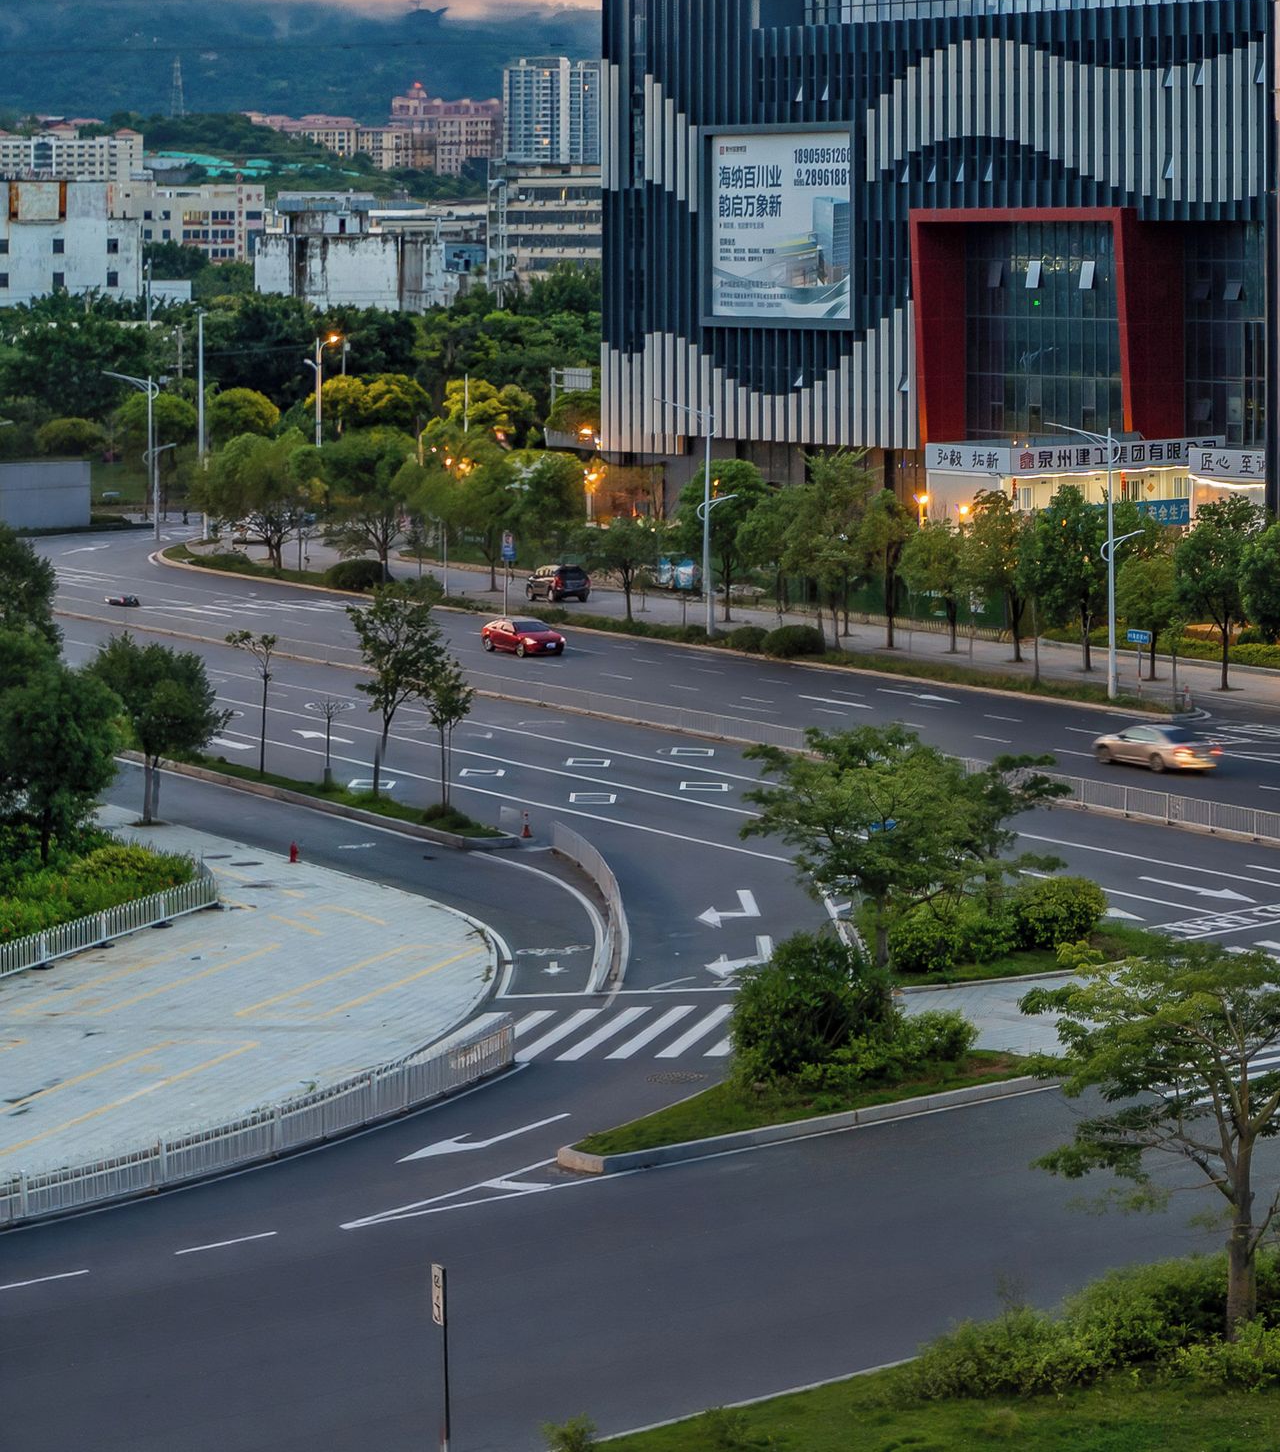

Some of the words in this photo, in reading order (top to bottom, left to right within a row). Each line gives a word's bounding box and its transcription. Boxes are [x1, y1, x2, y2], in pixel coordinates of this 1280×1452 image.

[719, 165, 782, 189] 海纳百川业
[719, 194, 782, 218] 韵启万象新
[937, 449, 963, 467] 弘毅
[972, 450, 999, 470] 拓新
[1200, 452, 1231, 472] 匠心
